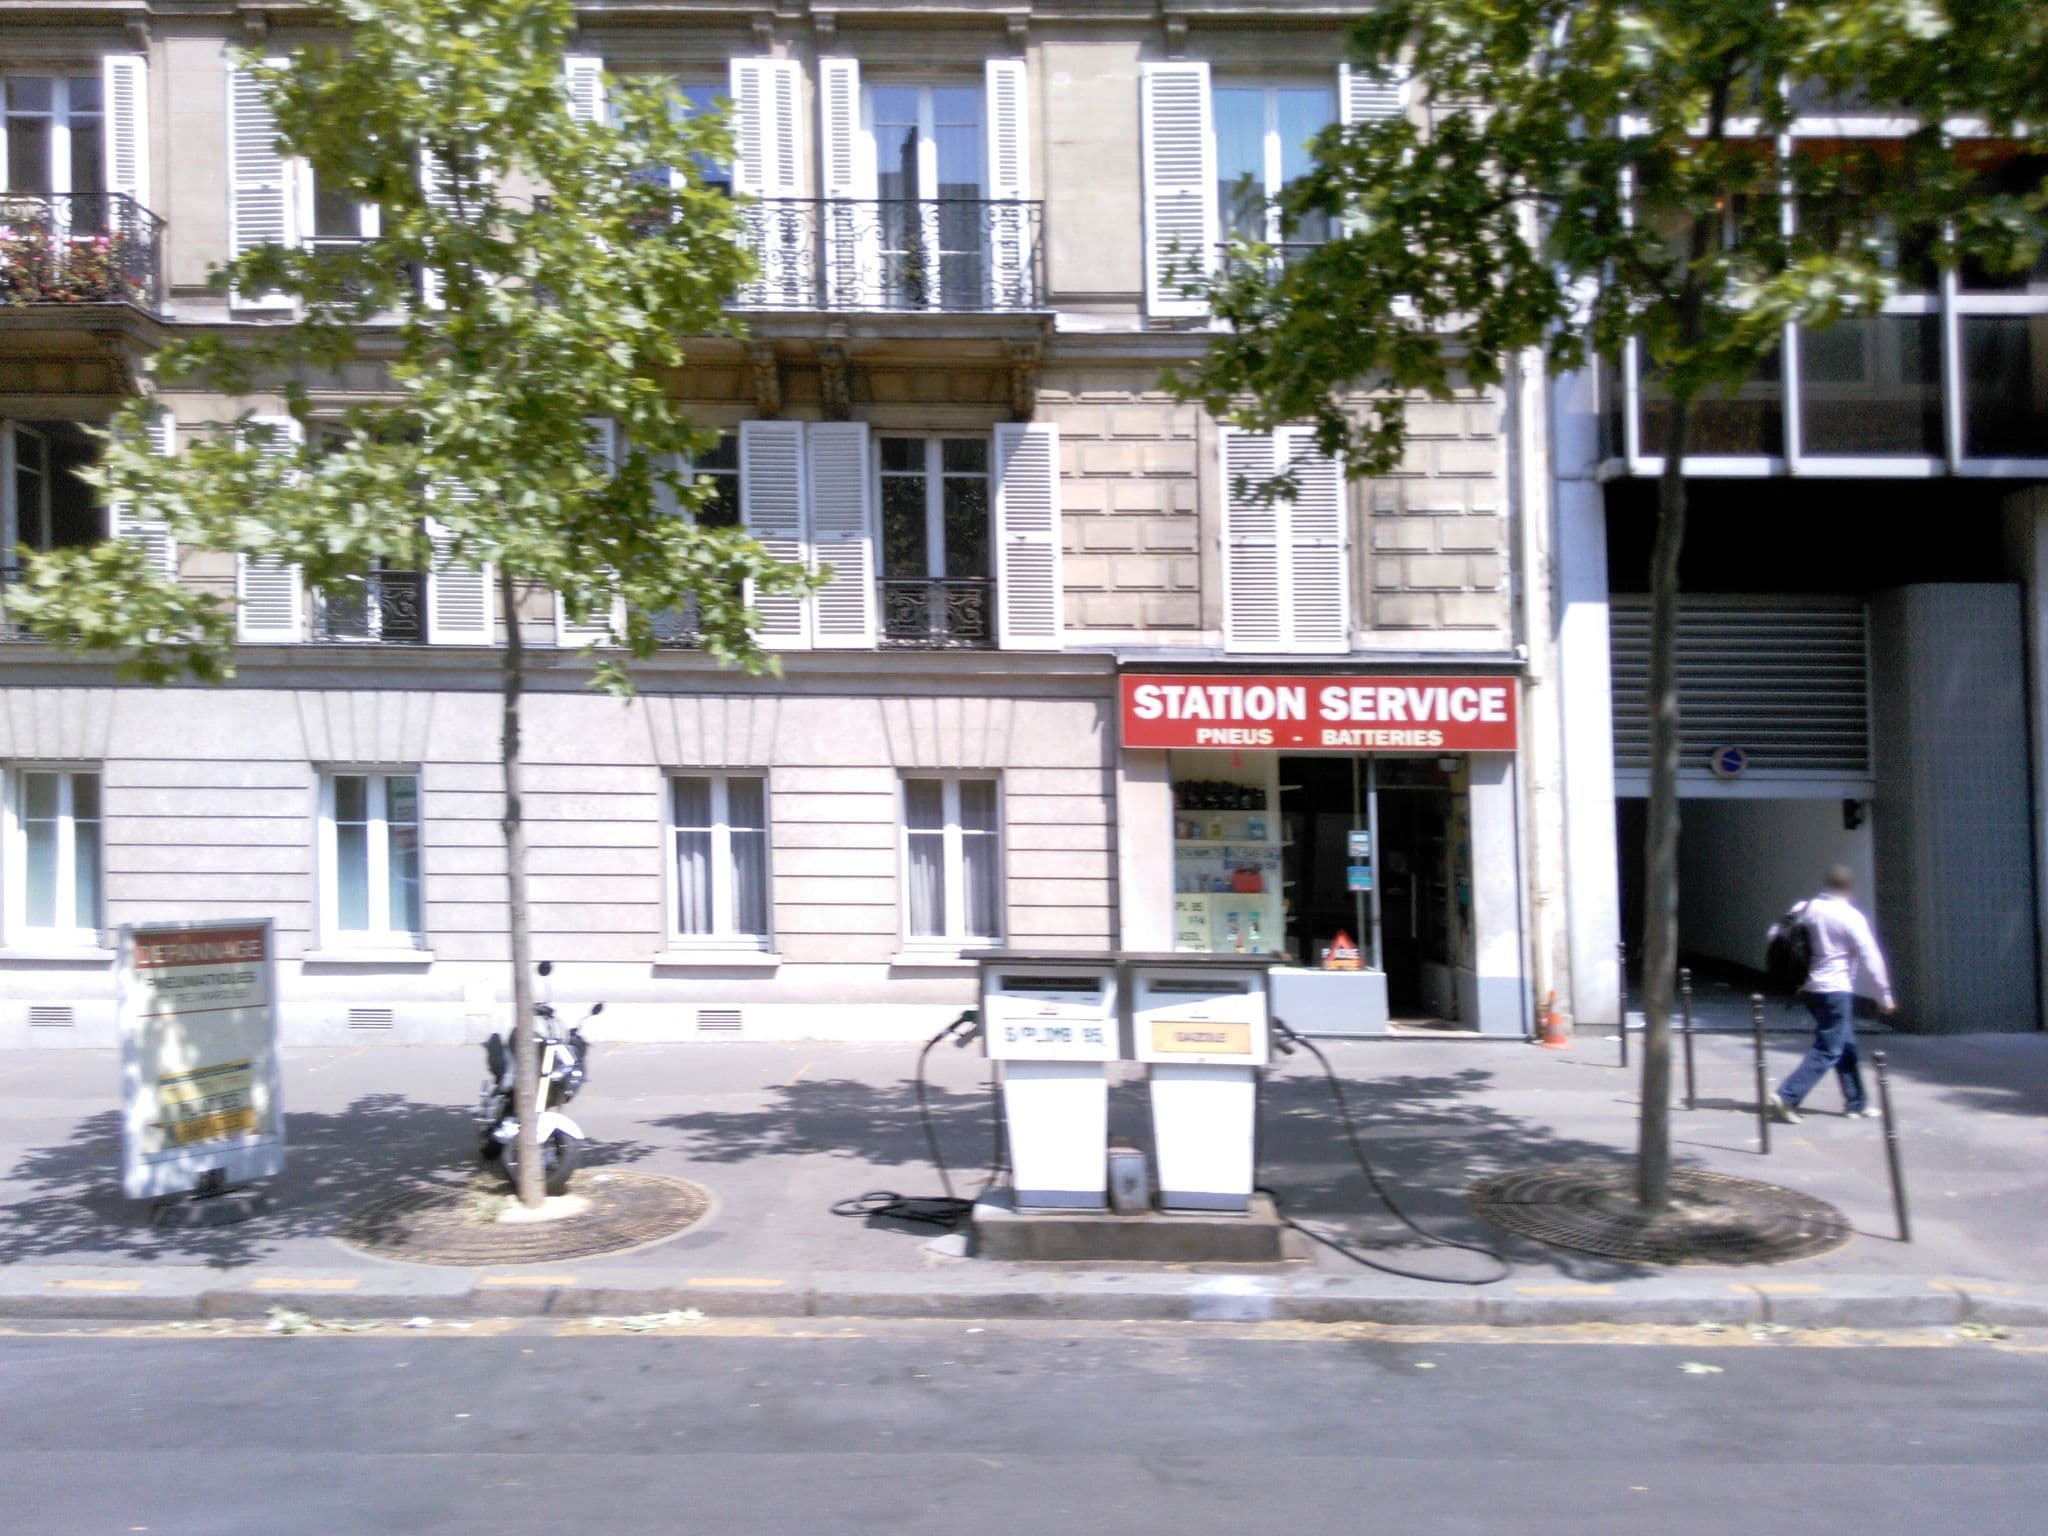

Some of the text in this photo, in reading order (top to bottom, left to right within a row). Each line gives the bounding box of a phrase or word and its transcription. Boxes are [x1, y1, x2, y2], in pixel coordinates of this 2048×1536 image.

[1133, 685, 1508, 723] STATION SERVICE
[1196, 728, 1273, 745] PNEUS
[1321, 729, 1444, 747] BATTERIES
